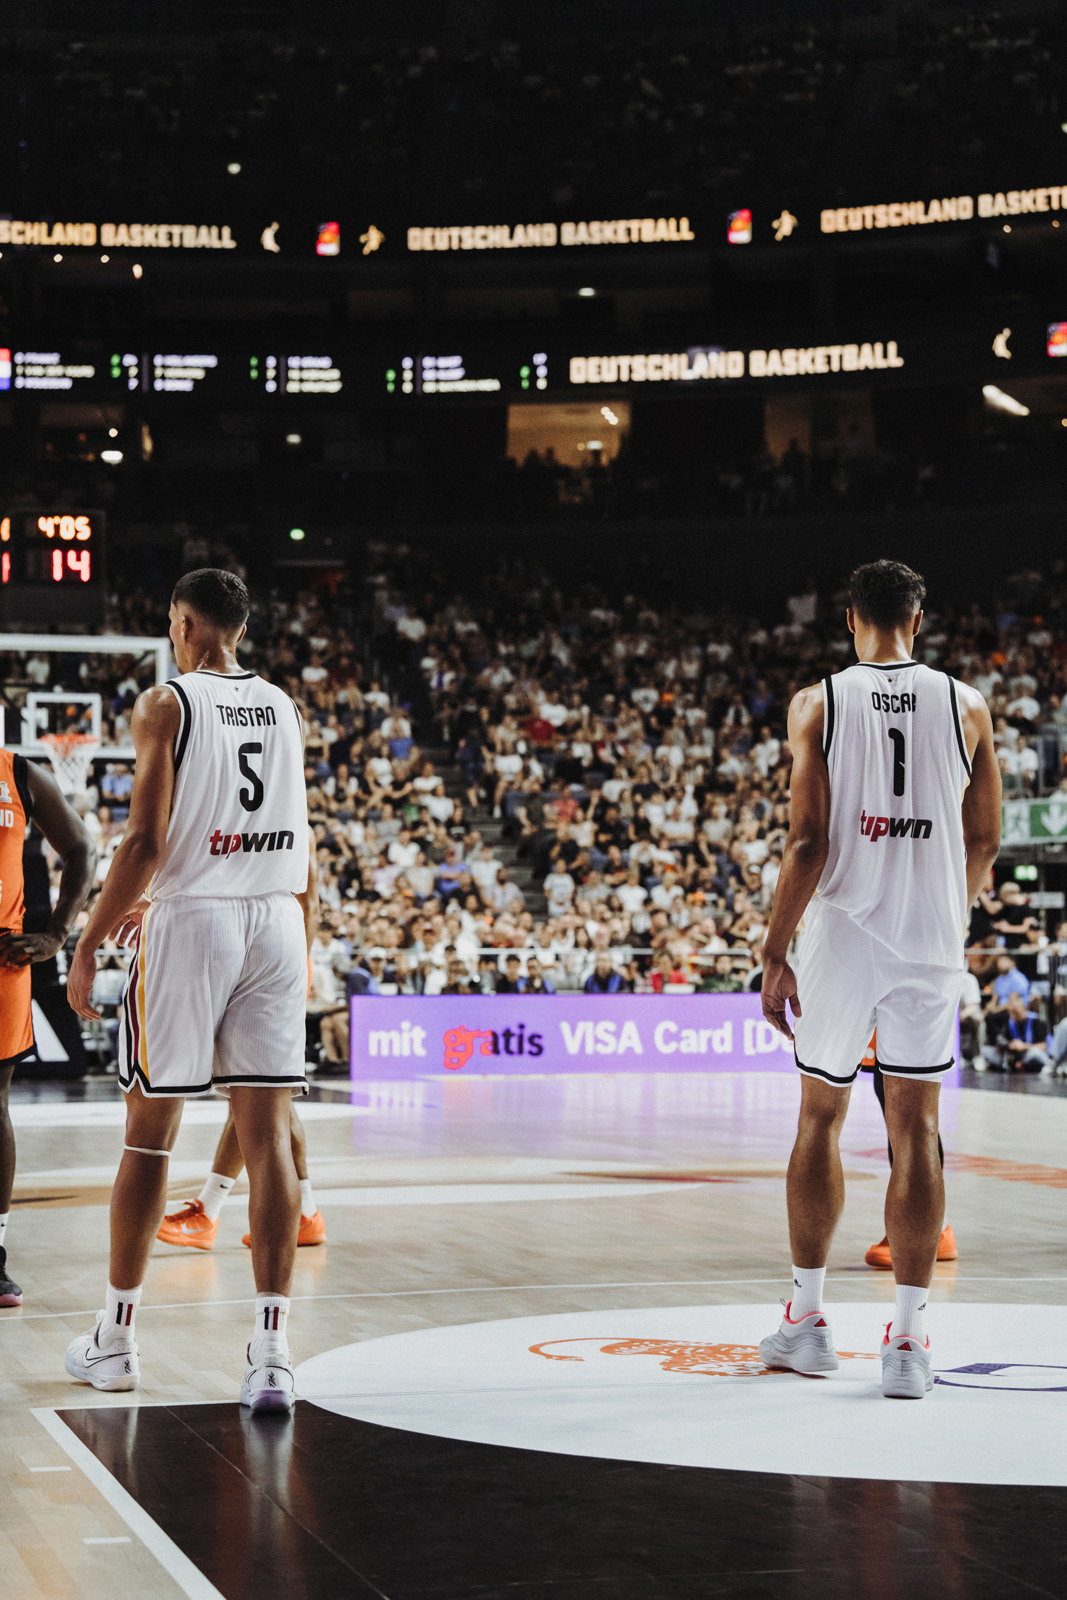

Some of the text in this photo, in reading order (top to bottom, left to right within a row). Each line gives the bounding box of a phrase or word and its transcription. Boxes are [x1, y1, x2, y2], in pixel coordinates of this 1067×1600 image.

[820, 195, 974, 234] DEUTSCHLAND
[100, 223, 237, 248] BASKETBALL
[407, 216, 695, 250] DEUTSCHLAND BASKETBALL
[569, 350, 745, 384] DEUTSCHLAND
[748, 340, 905, 377] BASKETBALL
[52, 548, 91, 582] 14
[216, 704, 277, 727] TRISTAN
[238, 742, 264, 812] 5
[888, 727, 905, 797] 1
[209, 829, 294, 860] tipwin
[368, 1021, 427, 1057] mit
[442, 1024, 544, 1070] gratis
[560, 1021, 644, 1055] VISA
[654, 1021, 733, 1055] Card
